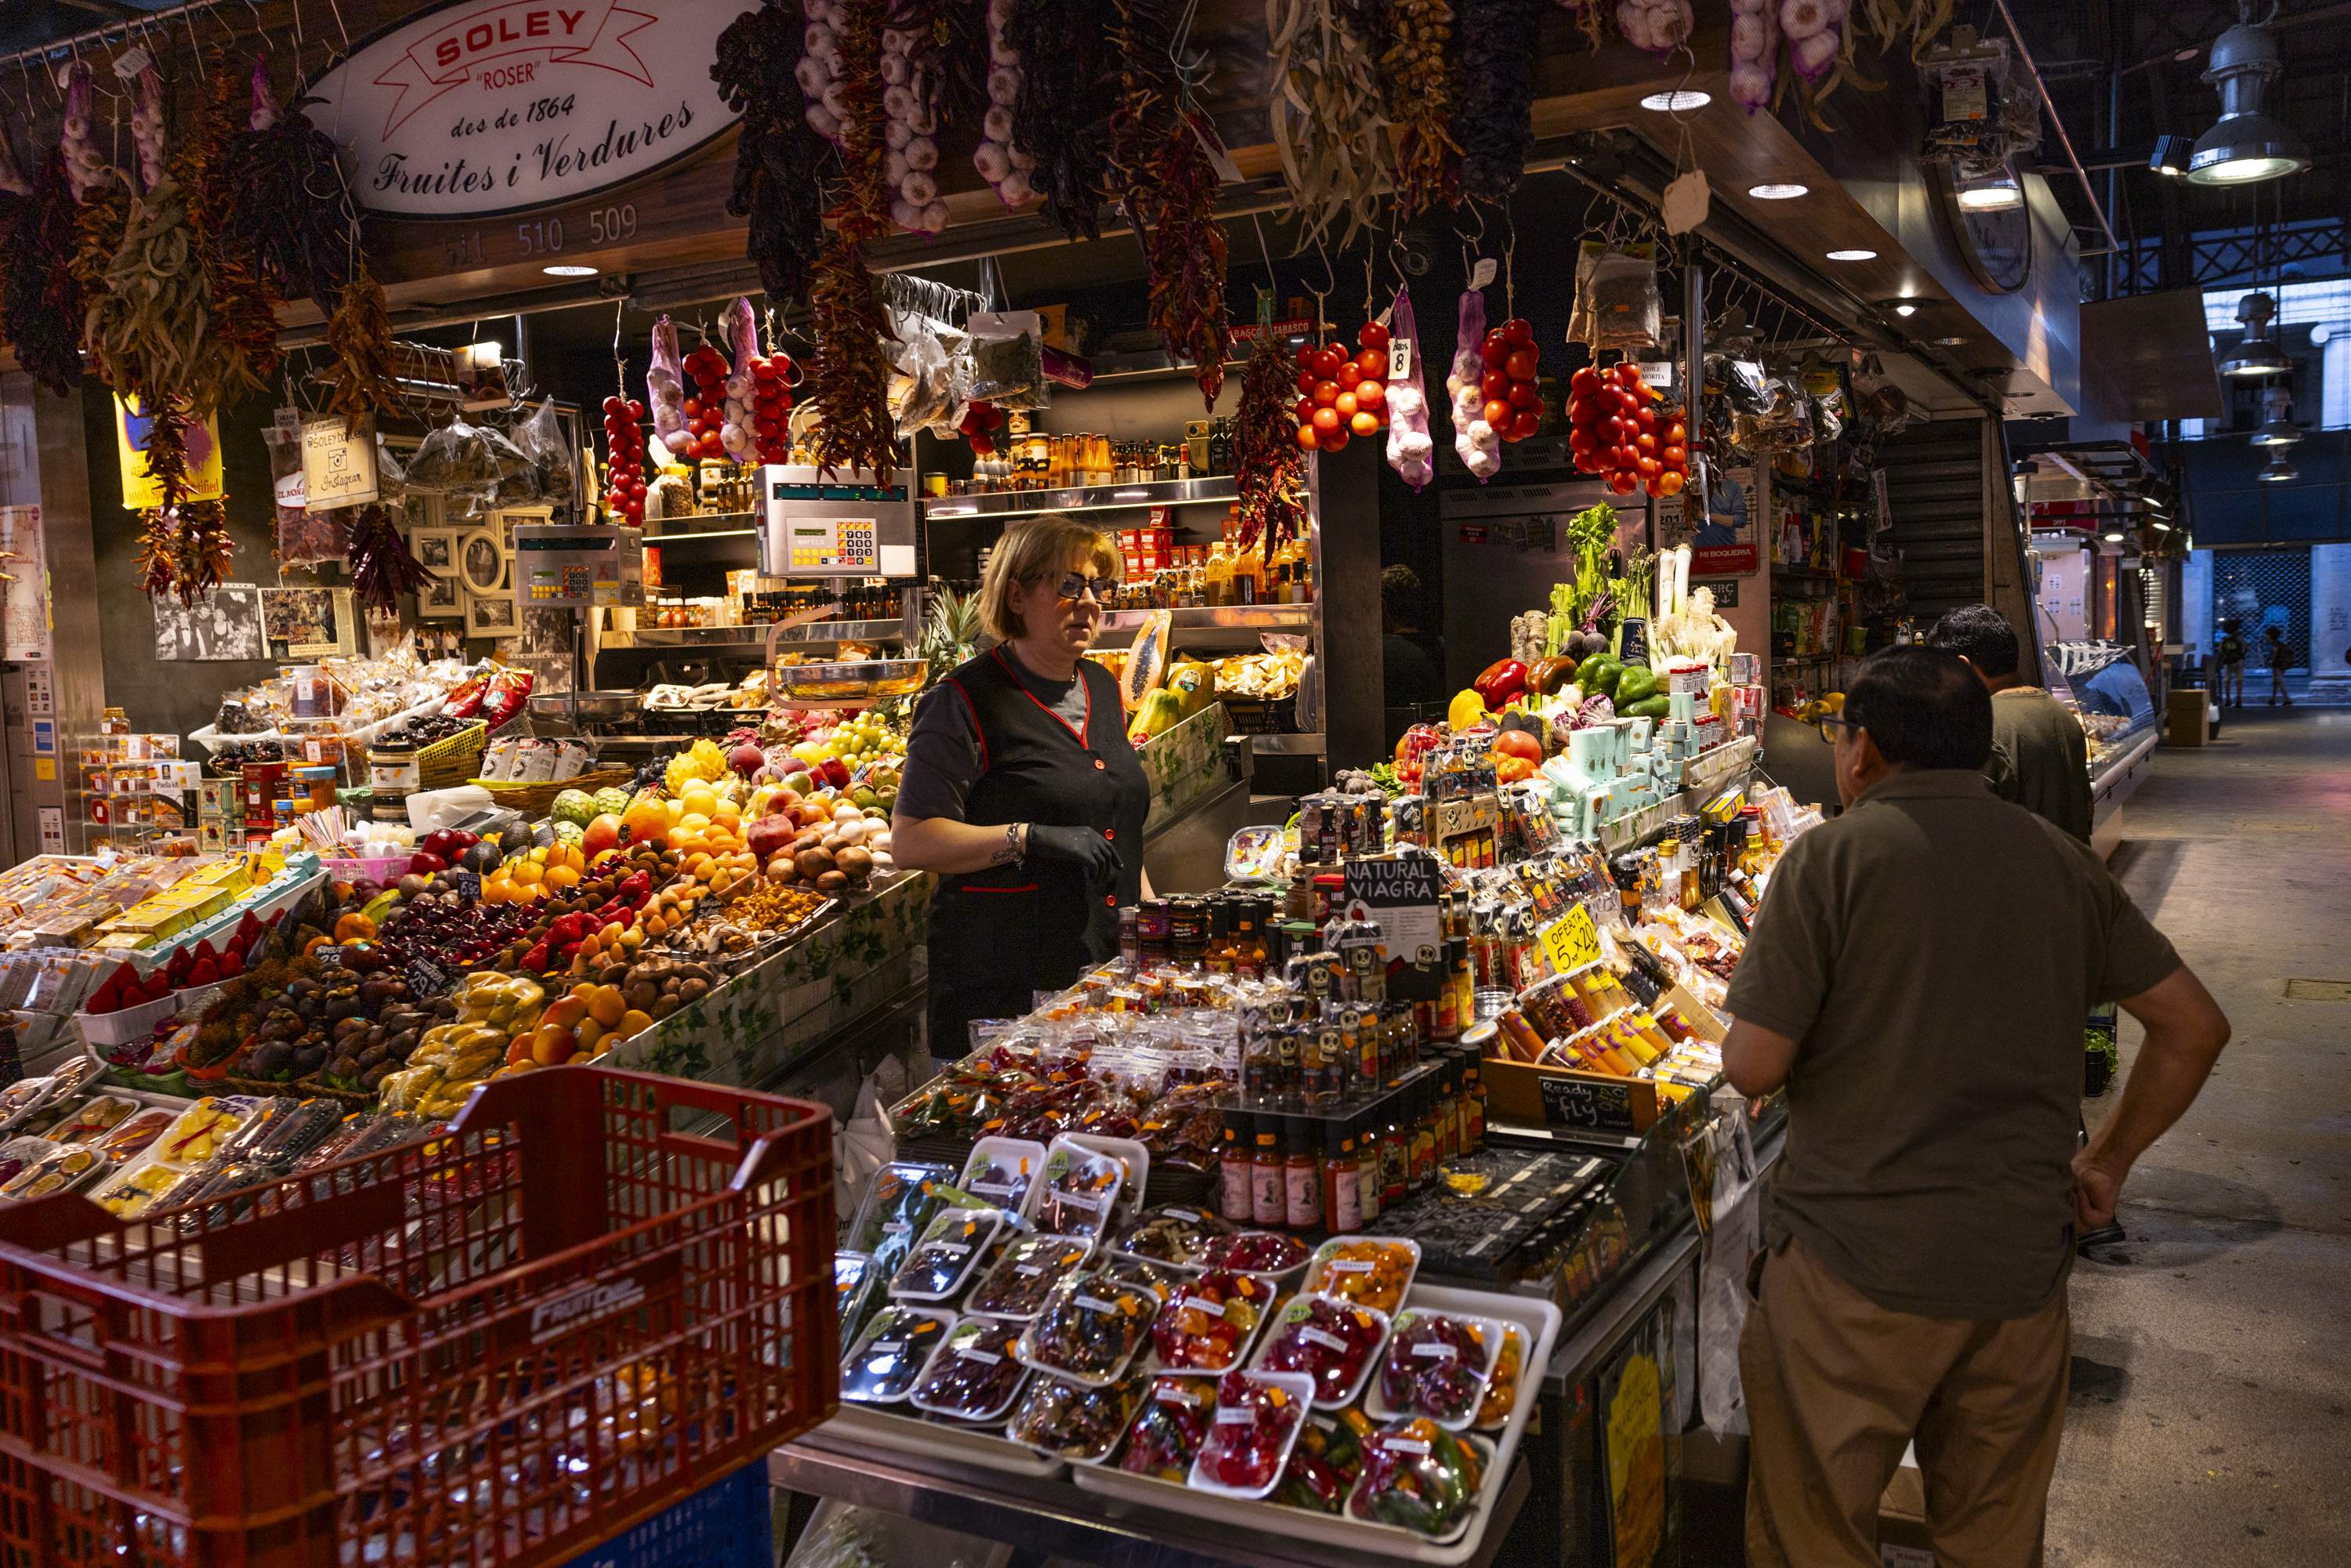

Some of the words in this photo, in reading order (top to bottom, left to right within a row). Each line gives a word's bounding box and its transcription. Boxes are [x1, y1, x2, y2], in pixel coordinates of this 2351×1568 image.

[436, 10, 585, 67] SOLEY
[451, 116, 487, 138] des
[495, 110, 519, 129] de
[526, 94, 576, 123] 1864
[373, 154, 495, 195] Fruites
[507, 154, 521, 187] i
[533, 100, 695, 181] Verdures
[518, 219, 564, 256] 510
[589, 205, 639, 244] 509
[1229, 327, 1262, 339] ABASCO
[1273, 322, 1309, 335] TABASCO
[1395, 353, 1404, 371] 8
[321, 473, 362, 492] Instagram
[1710, 549, 1751, 558] BOQUERIA
[1346, 862, 1431, 880] NATURAL
[1350, 881, 1433, 899] VIAGRA
[1551, 912, 1583, 945] OFERTA
[1557, 945, 1571, 970] 5
[1580, 923, 1594, 951] 20
[1542, 1081, 1592, 1102] Ready
